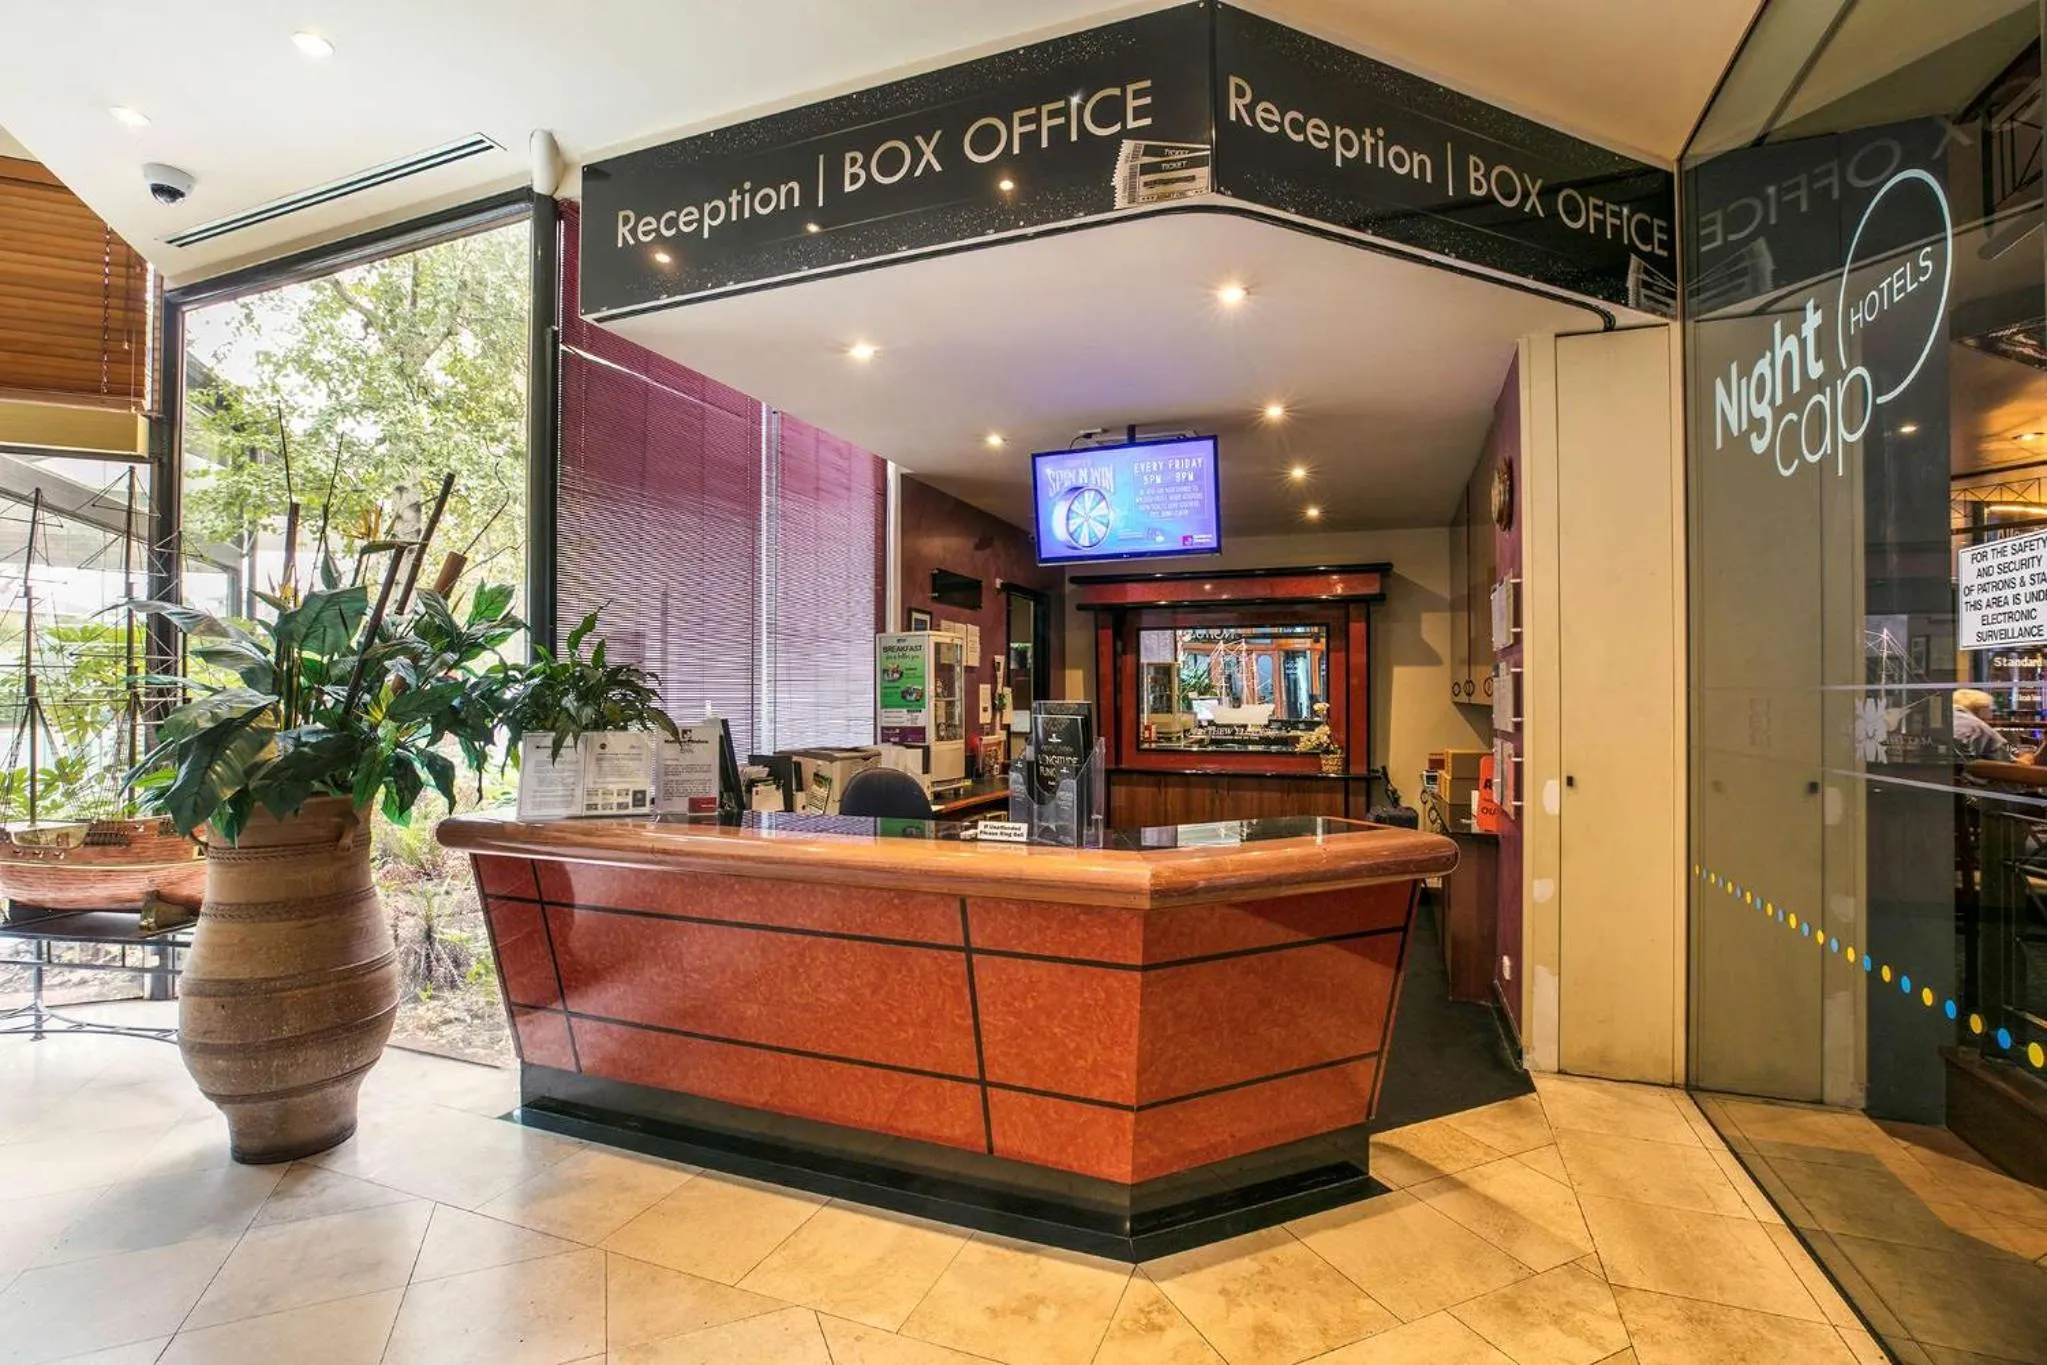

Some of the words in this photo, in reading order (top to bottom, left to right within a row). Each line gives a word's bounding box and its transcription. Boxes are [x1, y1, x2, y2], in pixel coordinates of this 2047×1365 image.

[617, 180, 800, 248] Reception
[844, 129, 943, 193] BOX
[963, 80, 1153, 164] OFFICE
[1228, 74, 1432, 183] Reception
[1469, 154, 1545, 218] BOX
[1558, 187, 1668, 257] OFFICE
[1850, 246, 1933, 335] HOTELS
[1715, 297, 1825, 454] Night
[1776, 366, 1873, 476] cap
[1133, 461, 1164, 474] EVERY
[1168, 458, 1204, 470] FRIDAY
[1971, 551, 1988, 565] FOR
[1991, 545, 2008, 560] THE
[2011, 536, 2047, 556] SAFETY
[1976, 565, 1994, 579] AND
[1997, 555, 2043, 576] SECURITY
[1963, 585, 1975, 597] OF
[1977, 577, 2016, 594] PATRONS
[2019, 575, 2026, 588] &
[1964, 600, 1983, 612] THIS
[1985, 595, 2009, 609] AREA
[2012, 593, 2021, 606] IS
[1981, 608, 2037, 626] ELECTRONIC
[1976, 625, 2044, 642] SURVEILLANCE
[883, 645, 922, 653] BREAKFAST
[1993, 655, 2043, 668] Standard
